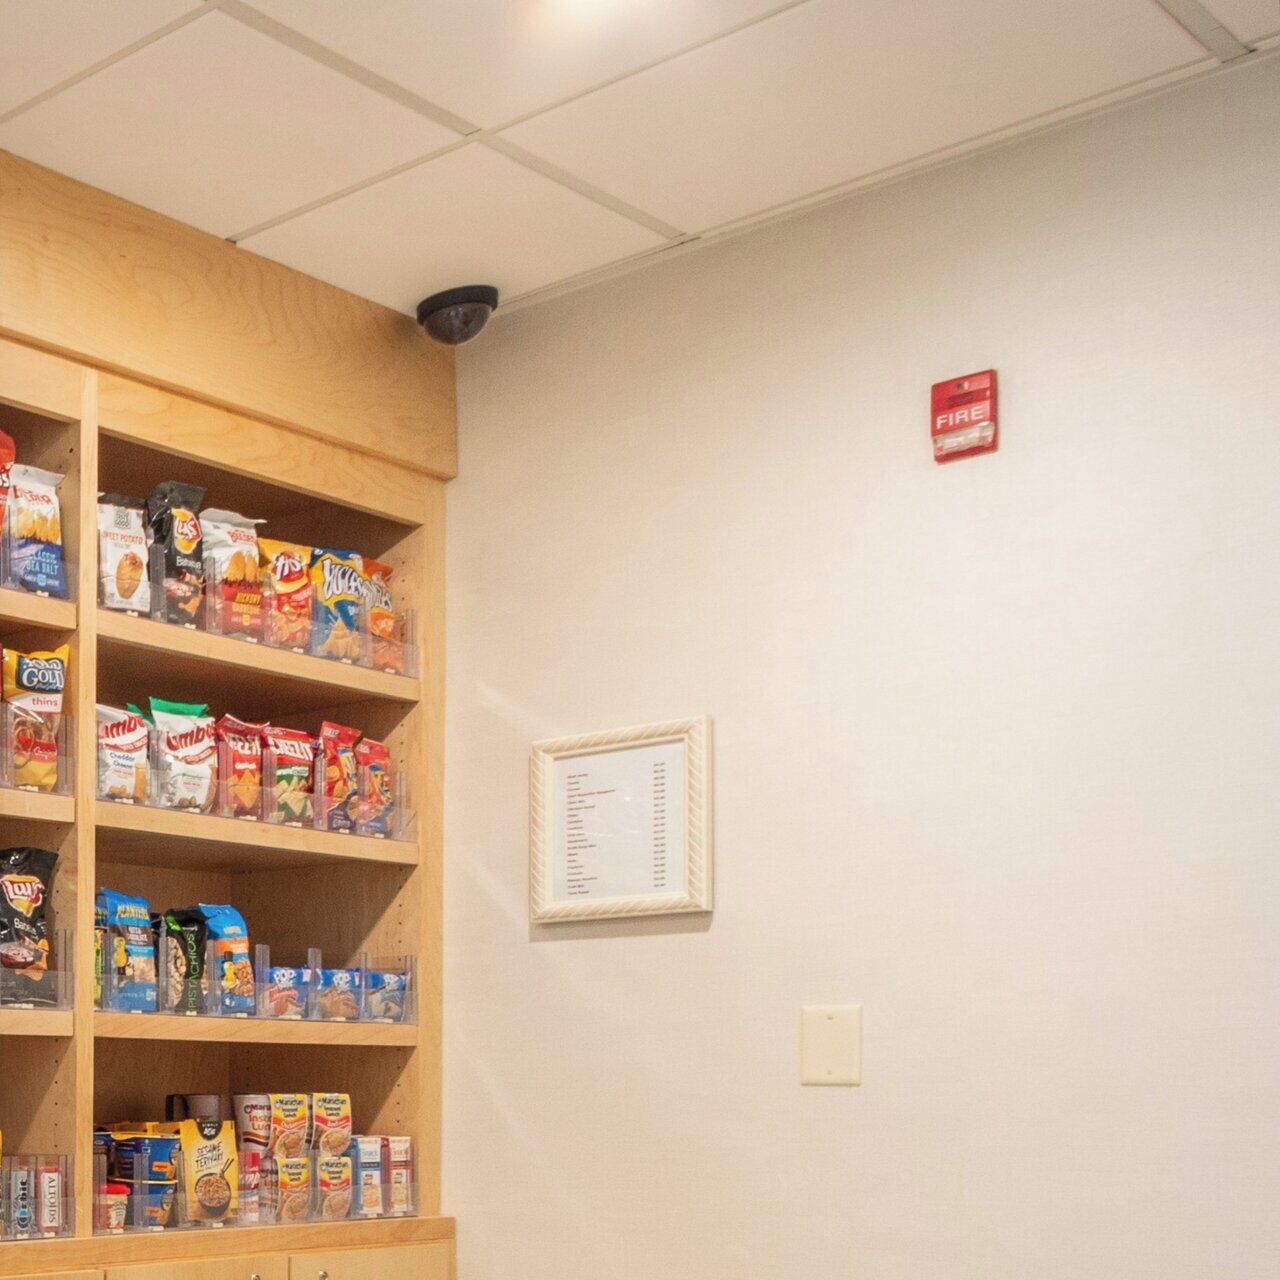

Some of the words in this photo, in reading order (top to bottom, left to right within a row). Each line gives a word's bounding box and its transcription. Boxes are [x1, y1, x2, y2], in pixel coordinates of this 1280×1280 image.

[935, 405, 986, 430] FIRE
[120, 534, 145, 545] POTATO
[42, 562, 59, 574] SALT
[22, 667, 66, 690] GOLD
[31, 696, 59, 707] thins
[196, 1141, 222, 1158] SESAME
[195, 1152, 224, 1168] TERIYAKI
[48, 1176, 57, 1224] ALTOIDS
